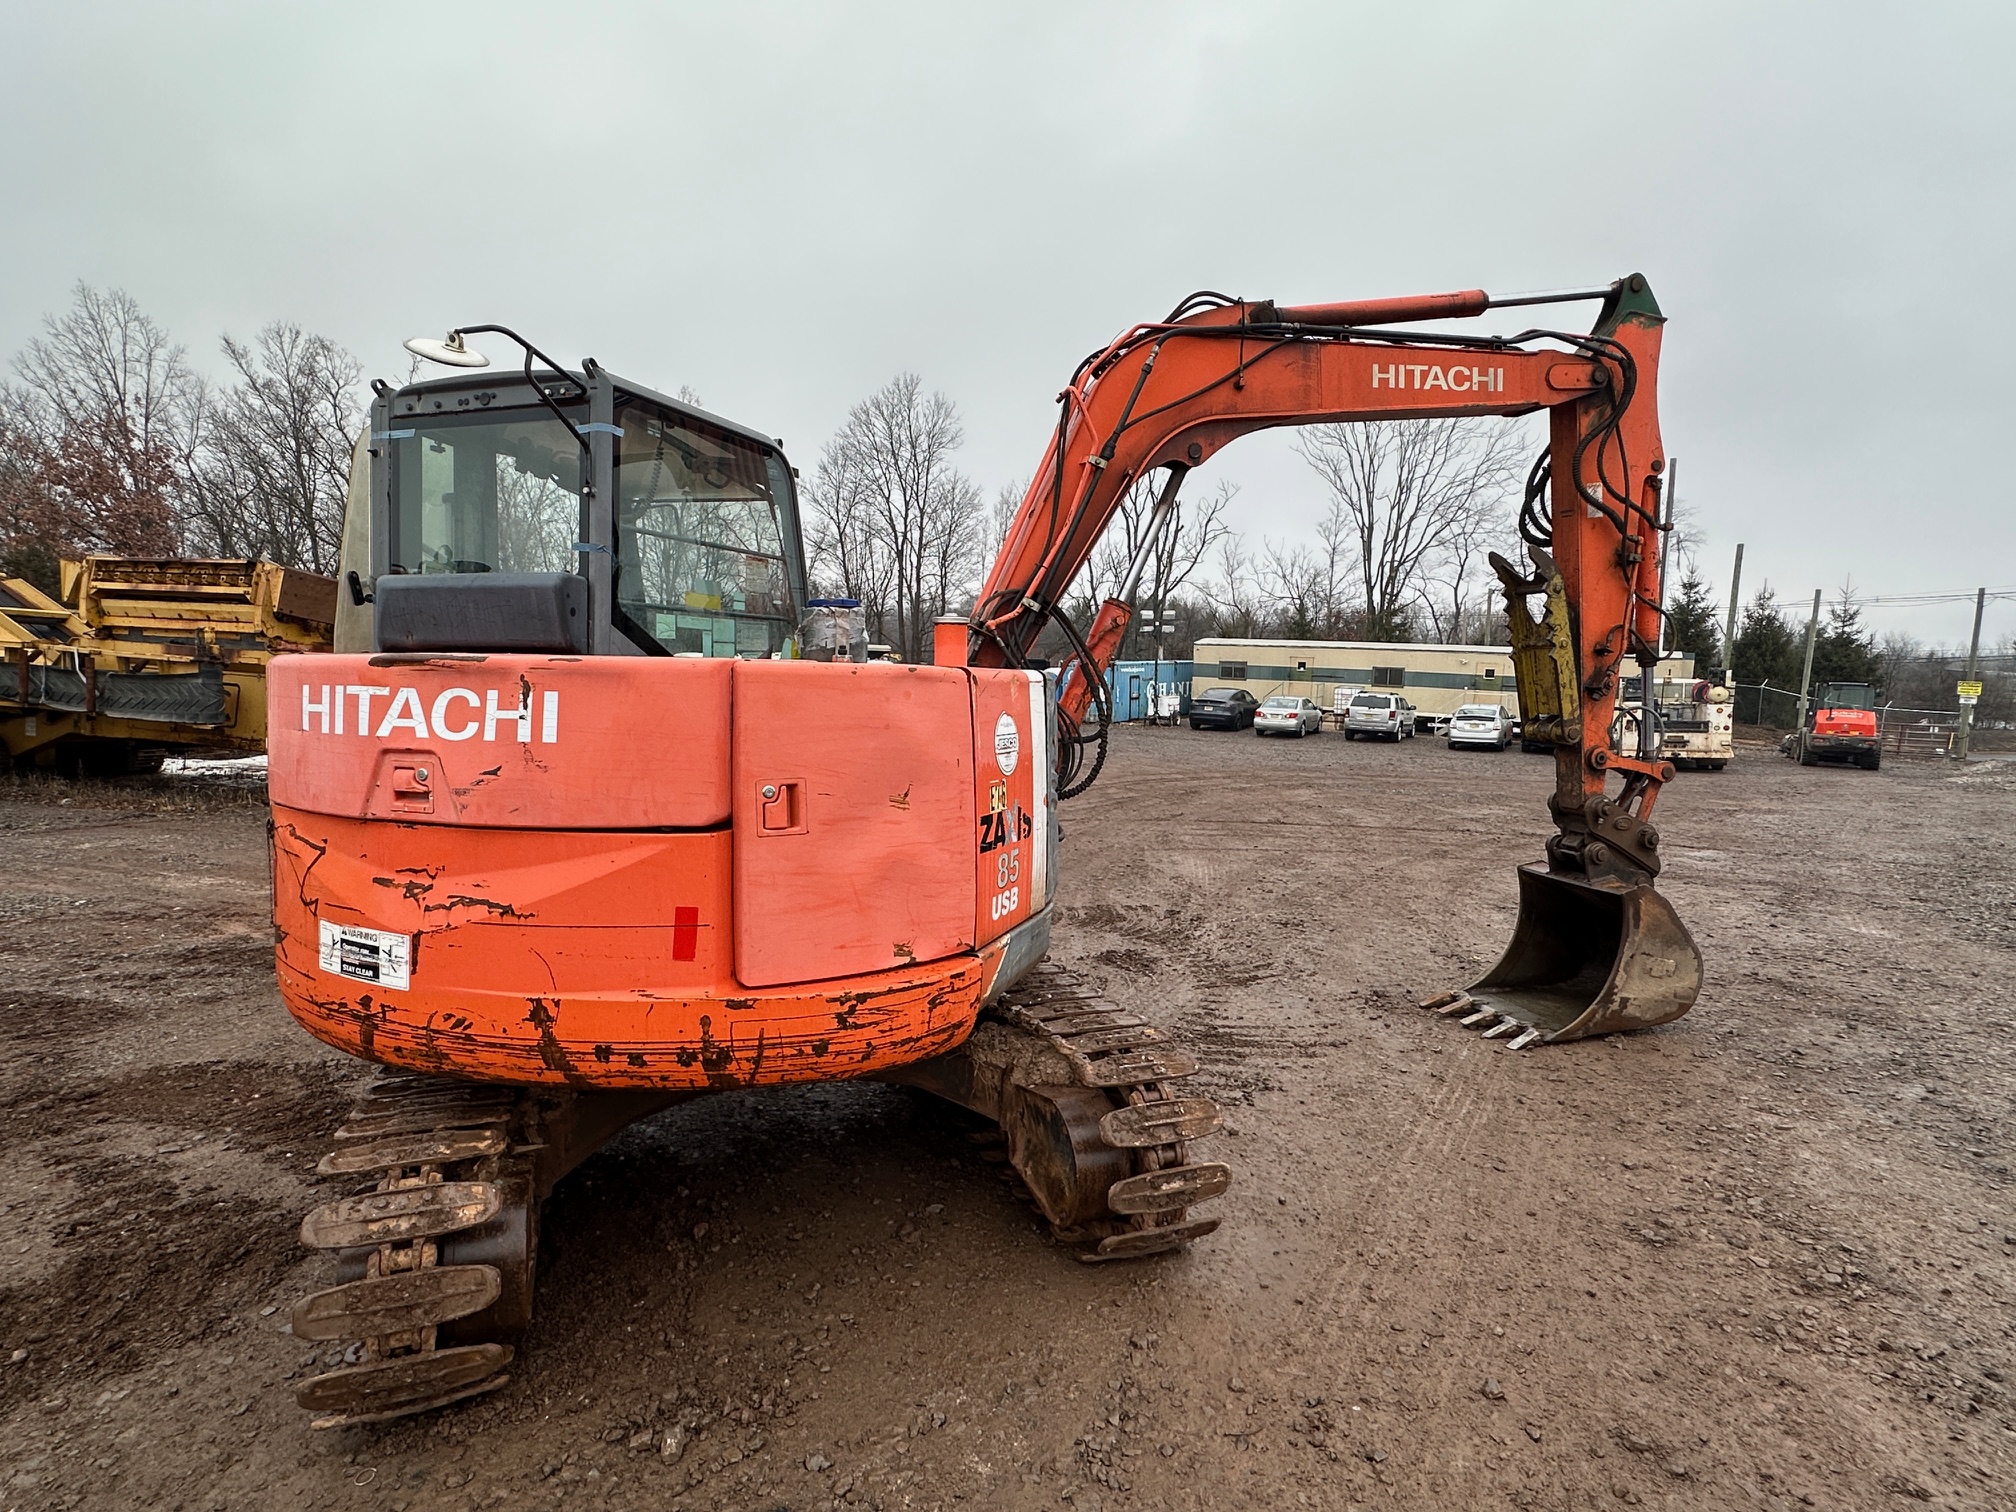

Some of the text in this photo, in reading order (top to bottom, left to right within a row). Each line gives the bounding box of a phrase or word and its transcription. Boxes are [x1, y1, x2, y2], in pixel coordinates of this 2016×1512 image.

[1372, 363, 1504, 392] HITACHI
[302, 684, 559, 743] HITACHI
[997, 737, 1018, 750] JESCO
[997, 849, 1020, 889] 85
[991, 886, 1019, 921] USB
[347, 928, 378, 942] WARNING
[342, 964, 374, 977] STAY CLEAR
